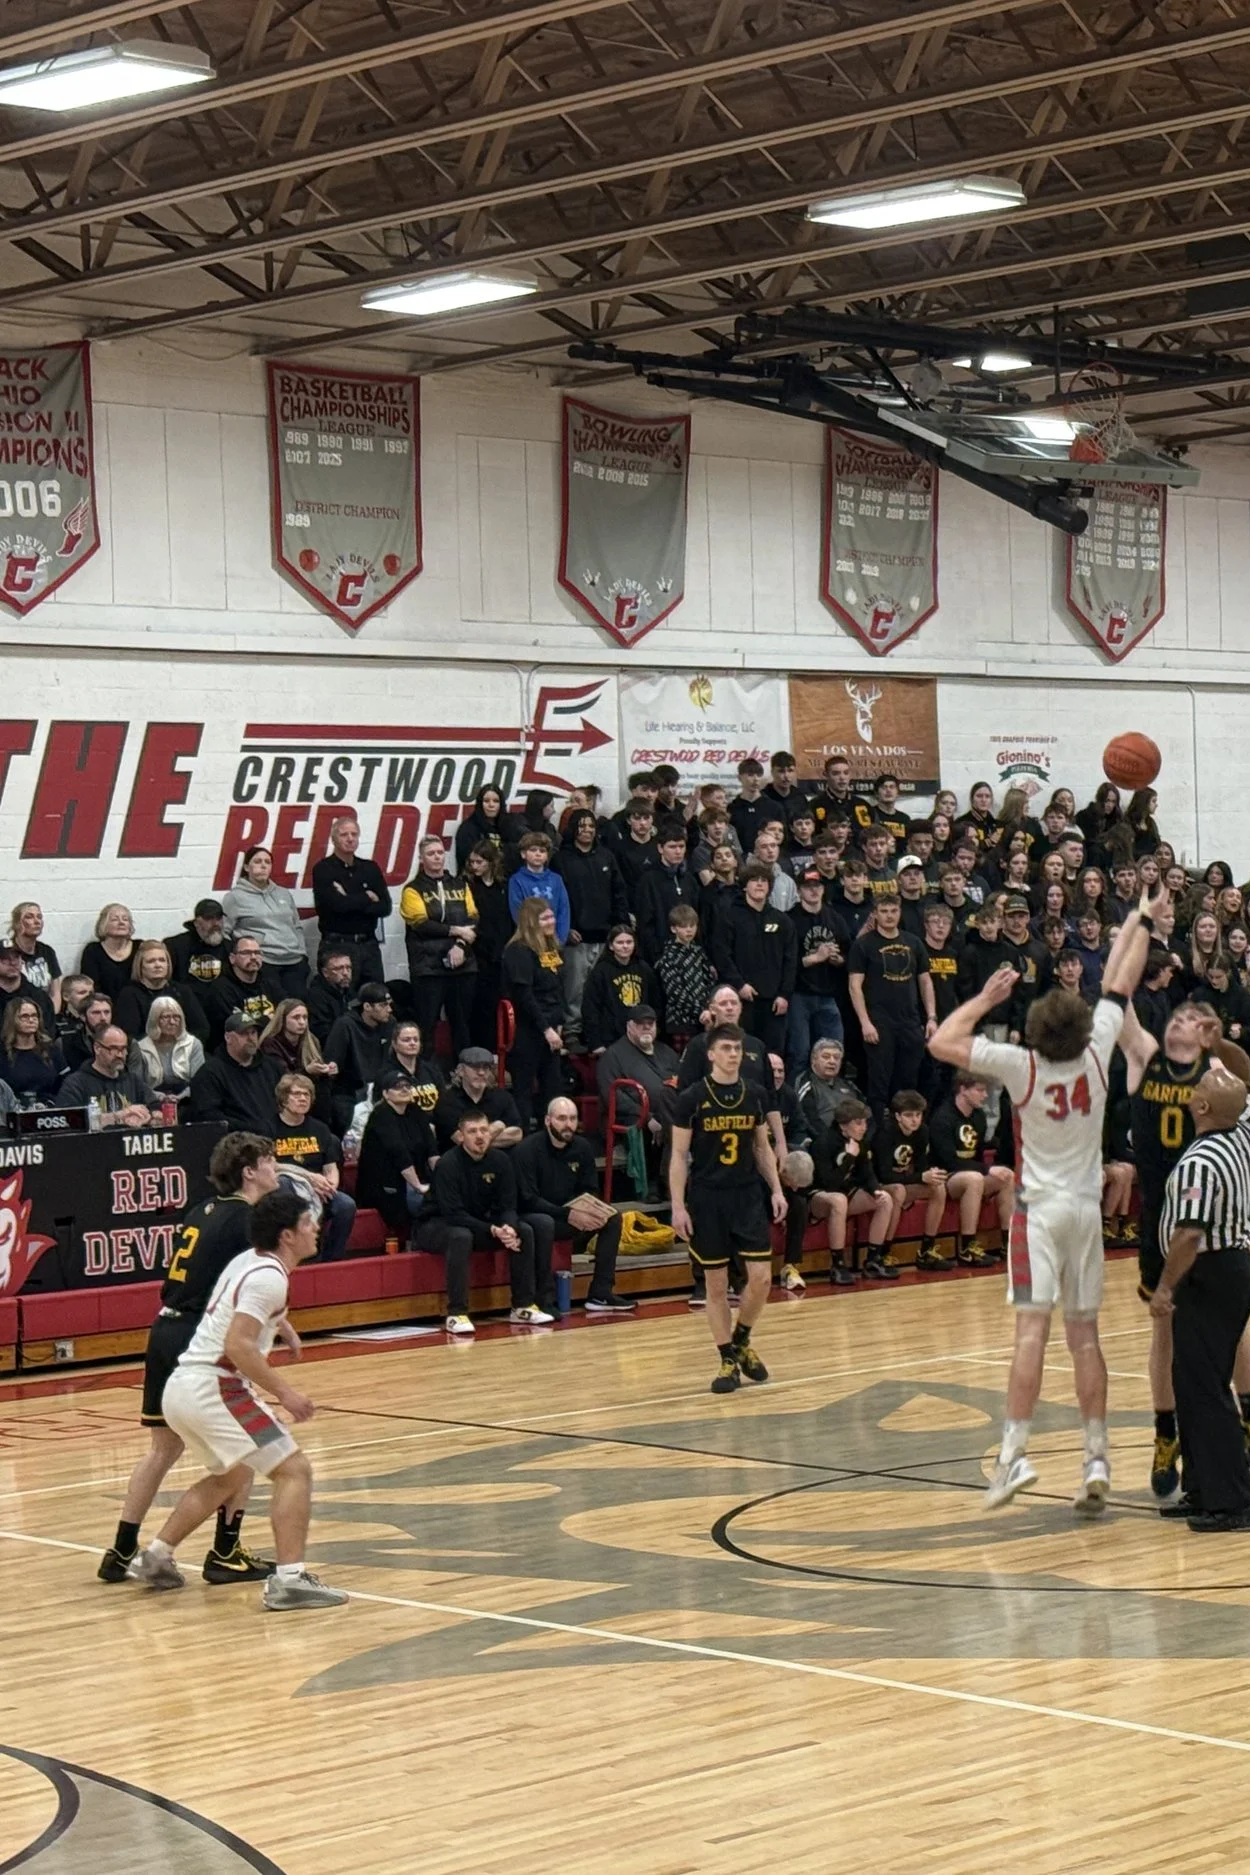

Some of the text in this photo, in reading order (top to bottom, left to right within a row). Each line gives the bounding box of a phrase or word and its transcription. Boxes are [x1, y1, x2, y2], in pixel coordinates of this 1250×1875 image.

[279, 375, 408, 407] BASKETBALL
[280, 396, 411, 434] CHAMPIONSHIPS
[318, 420, 376, 437] LEAGUE
[582, 413, 672, 442] BOWLING
[343, 504, 400, 521] CHAMPION
[662, 722, 694, 734] Hearing
[631, 749, 700, 766] CRESTWOOD
[703, 749, 727, 767] RED
[822, 744, 908, 757] LOS VENADOS
[996, 749, 1051, 768] Gionino's
[232, 756, 517, 804] CRESTWOOD
[1044, 1073, 1092, 1122] 34
[1160, 1106, 1184, 1149] 0
[122, 1133, 173, 1156] TABLE
[720, 1132, 738, 1165] 3
[111, 1165, 187, 1214] RED
[83, 1224, 184, 1276] DEVI
[168, 1226, 199, 1283] 2
